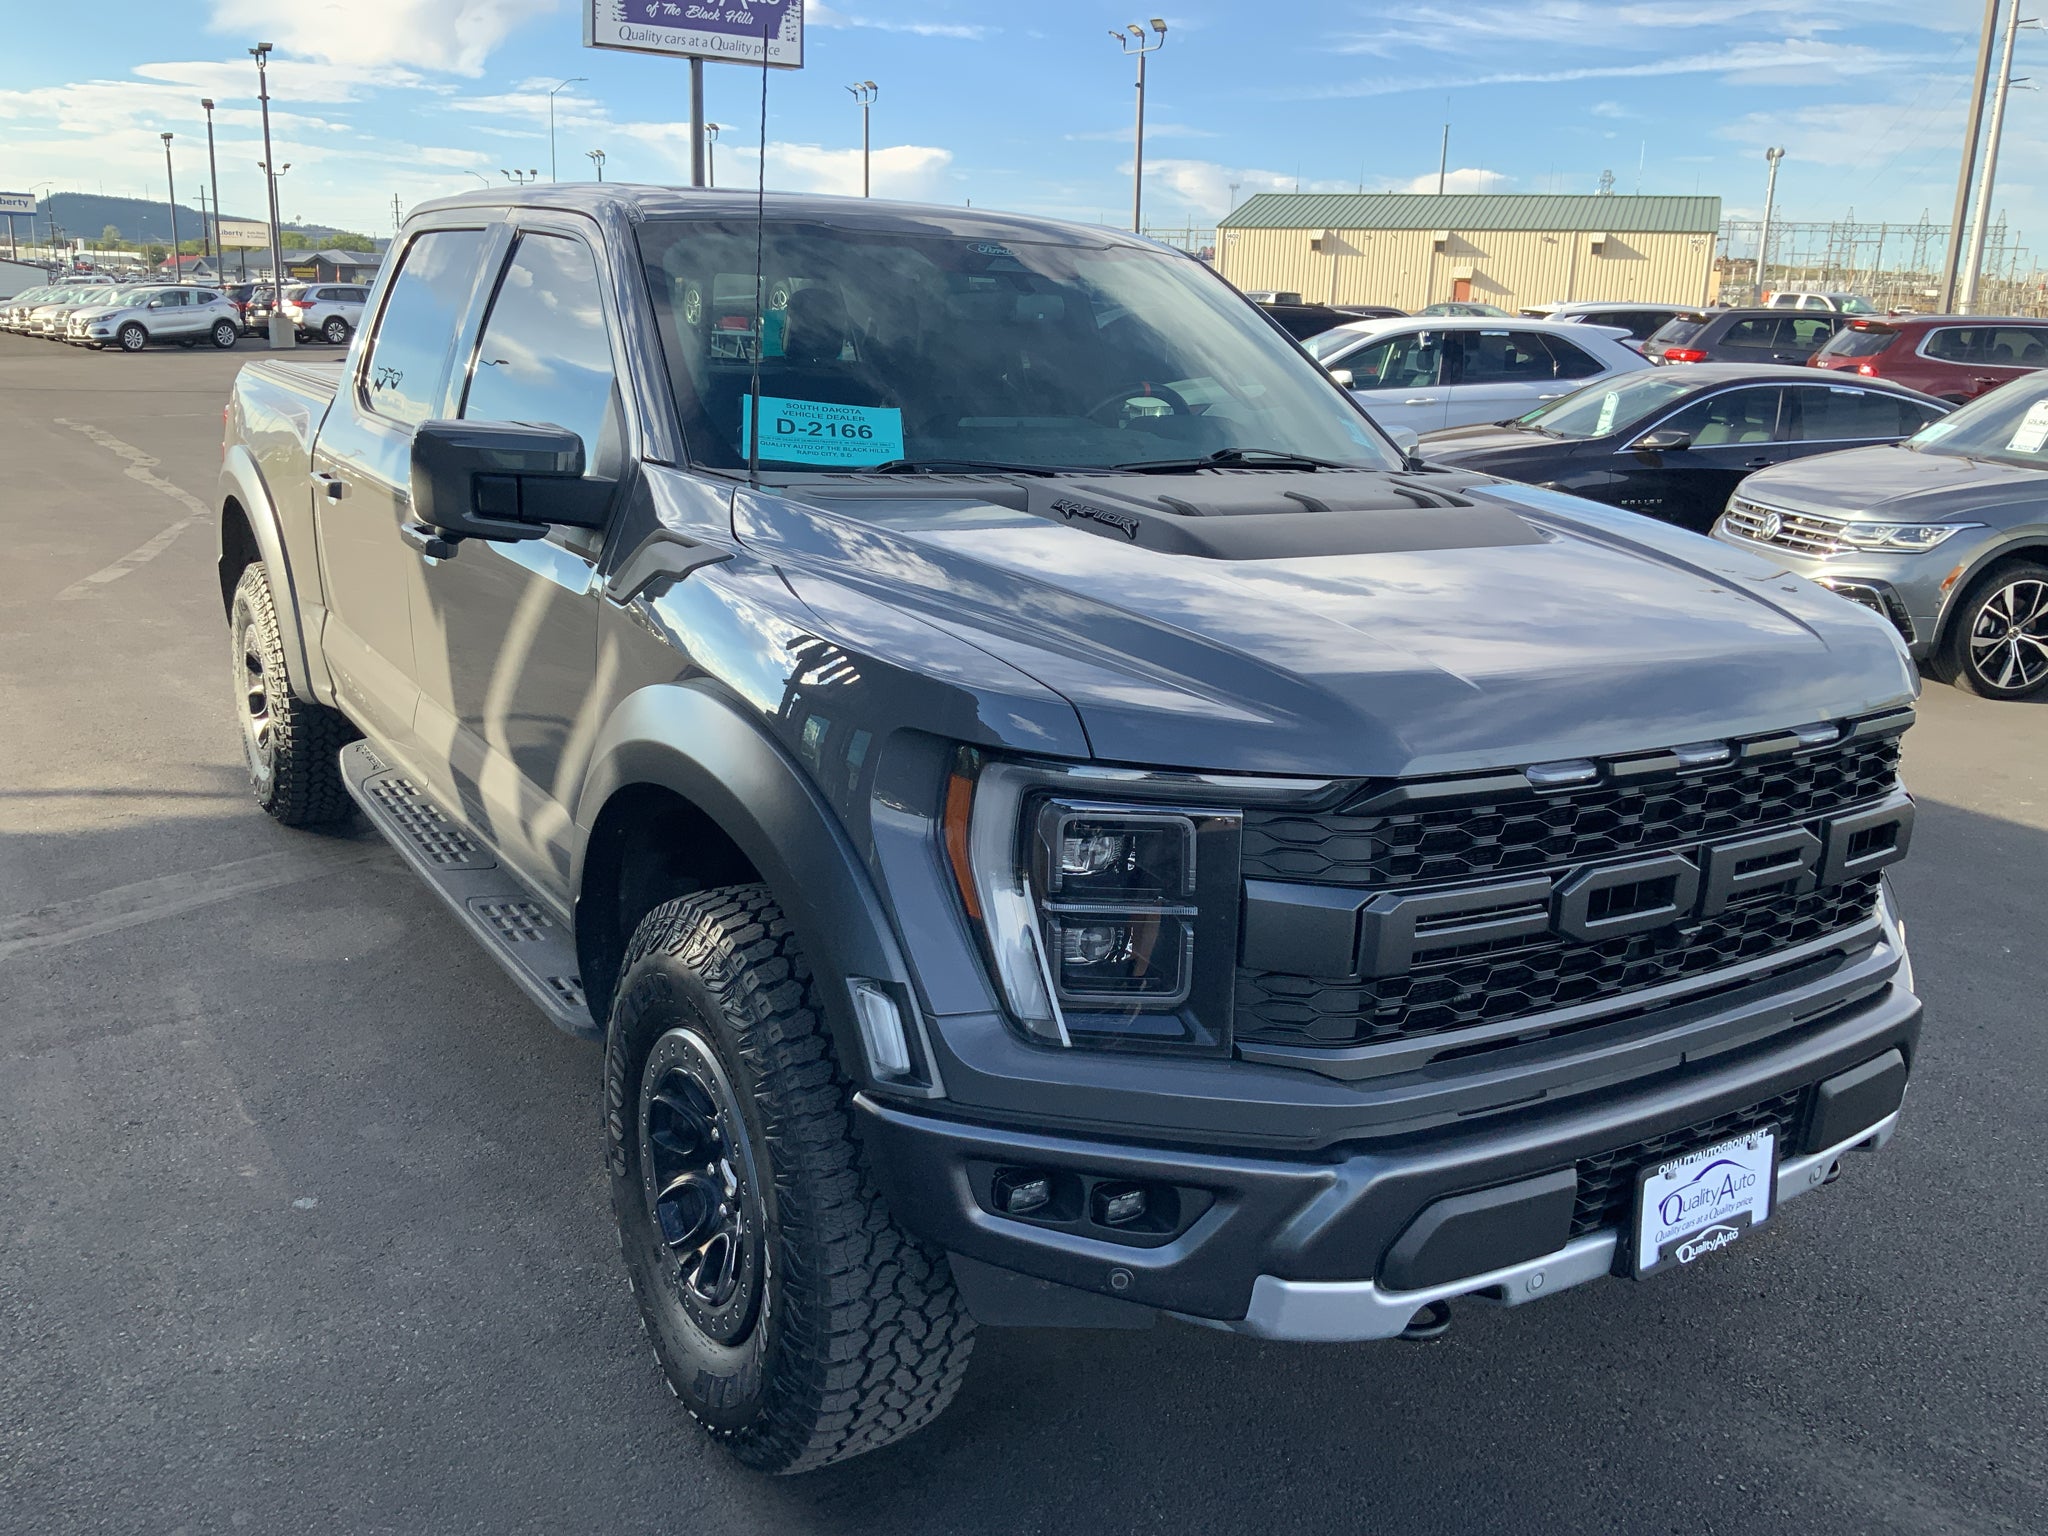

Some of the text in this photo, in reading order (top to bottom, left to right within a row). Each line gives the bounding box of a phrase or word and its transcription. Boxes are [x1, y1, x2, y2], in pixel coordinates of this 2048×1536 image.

[646, 1, 660, 18] of
[662, 2, 681, 16] The
[685, 5, 721, 21] Black
[725, 10, 754, 25] Hills
[619, 25, 781, 56] Quality cars at a Quality prce
[220, 229, 243, 237] iberty
[782, 409, 865, 422] VEHICLE DEALER
[785, 402, 862, 415] SOUTH DAKOTA
[776, 417, 873, 439] D-2166
[759, 440, 792, 448] QUALITY
[1050, 498, 1139, 540] RAPTOR
[1356, 793, 1917, 978] FORD
[1655, 1225, 1681, 1243] Quality
[1682, 1218, 1695, 1231] cars
[1696, 1214, 1704, 1225] at
[1709, 1202, 1735, 1220] Quality
[1736, 1196, 1753, 1211] price
[1679, 1230, 1739, 1264] QualityAuto
